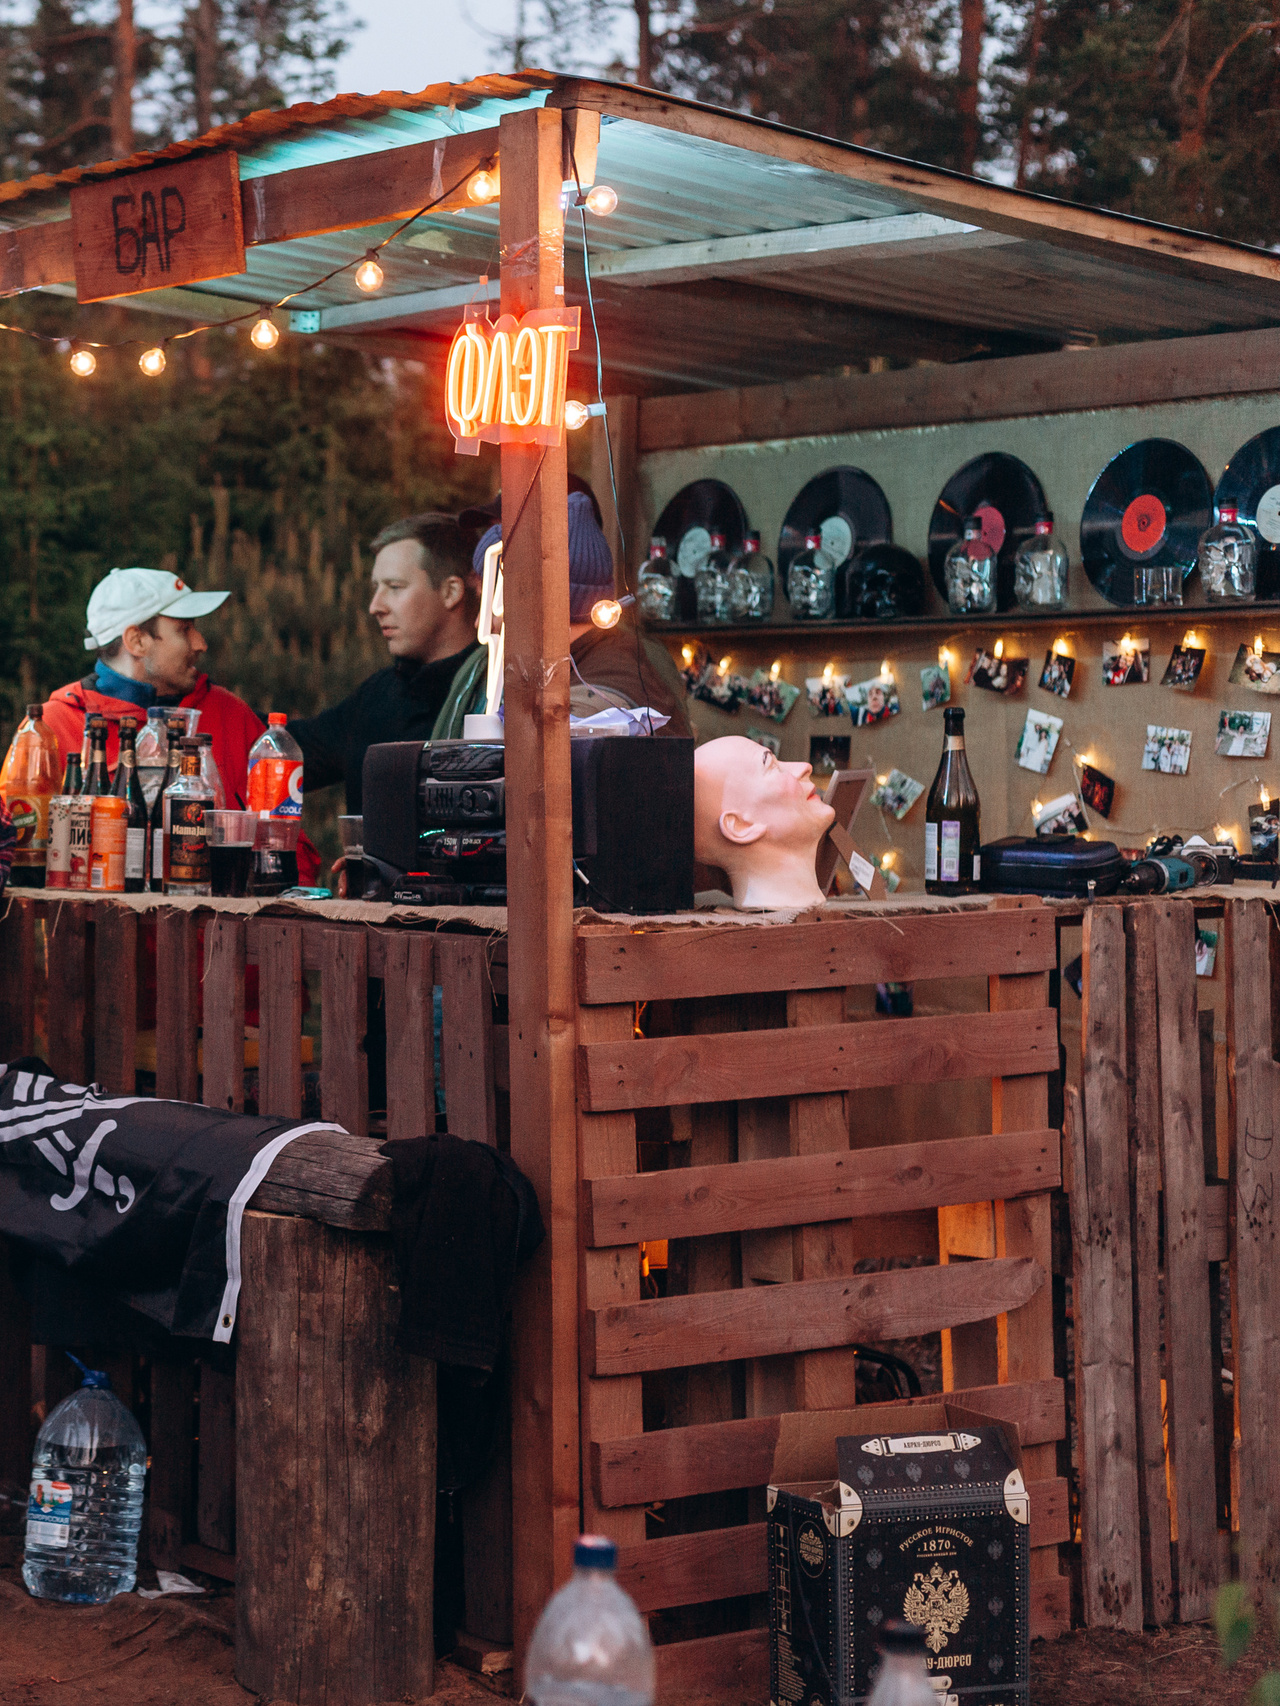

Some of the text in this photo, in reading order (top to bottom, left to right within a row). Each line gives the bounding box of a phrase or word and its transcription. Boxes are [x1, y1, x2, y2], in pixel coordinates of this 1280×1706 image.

[112, 186, 186, 278] БАР
[447, 323, 578, 438] ФЛЭТ
[898, 1525, 974, 1552] РУССКОЕ ИГРИСТОЕ
[923, 1538, 952, 1552] 1870
[926, 1654, 973, 1670] У-ДЮРСО
